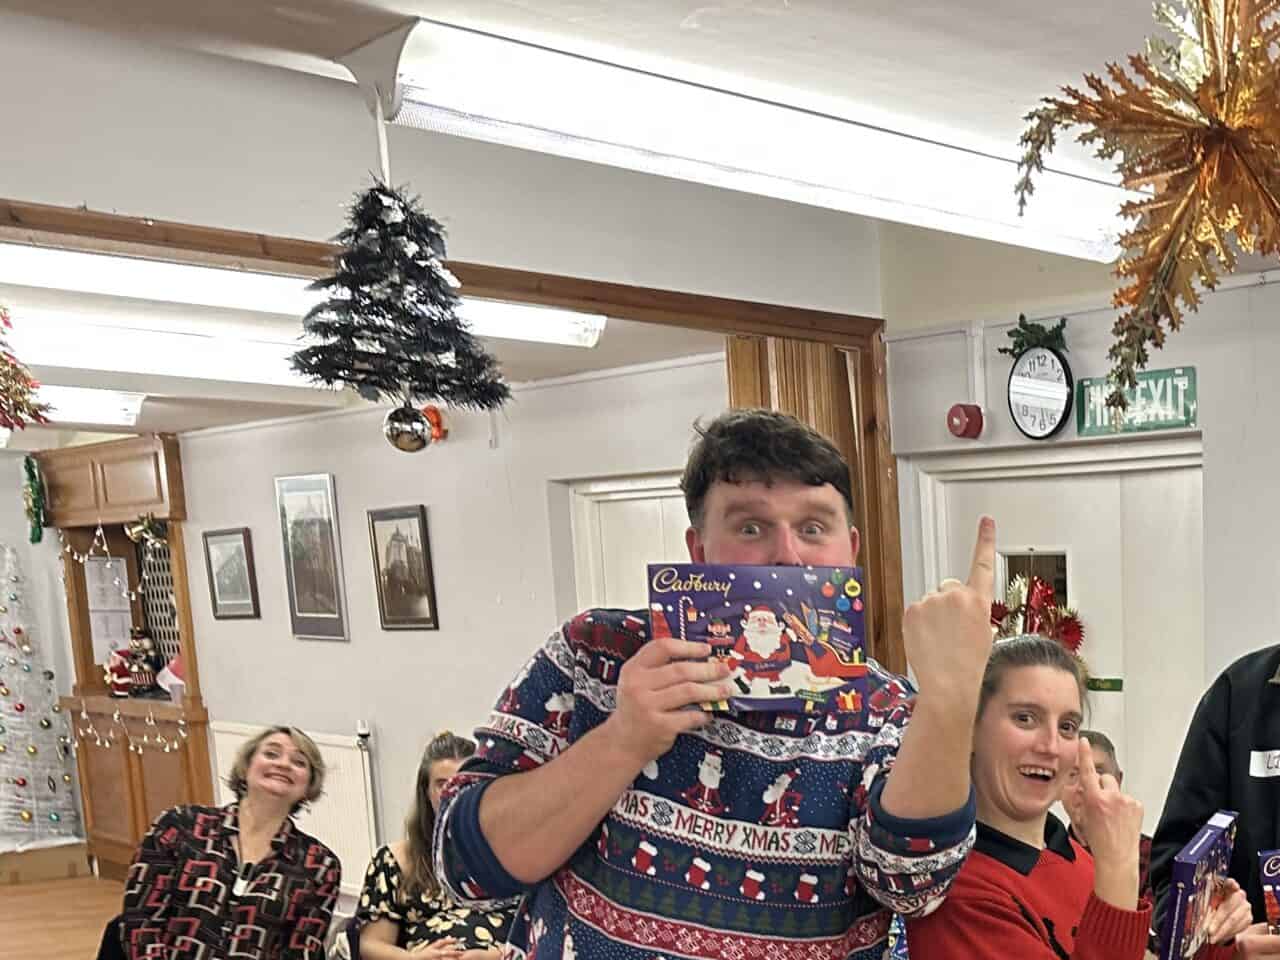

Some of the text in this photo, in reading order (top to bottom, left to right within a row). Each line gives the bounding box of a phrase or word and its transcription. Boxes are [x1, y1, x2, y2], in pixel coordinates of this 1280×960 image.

[1135, 376, 1188, 422] EXIT
[652, 567, 732, 599] Cadbury
[674, 809, 738, 844] MERRY
[740, 821, 791, 851] XMAS
